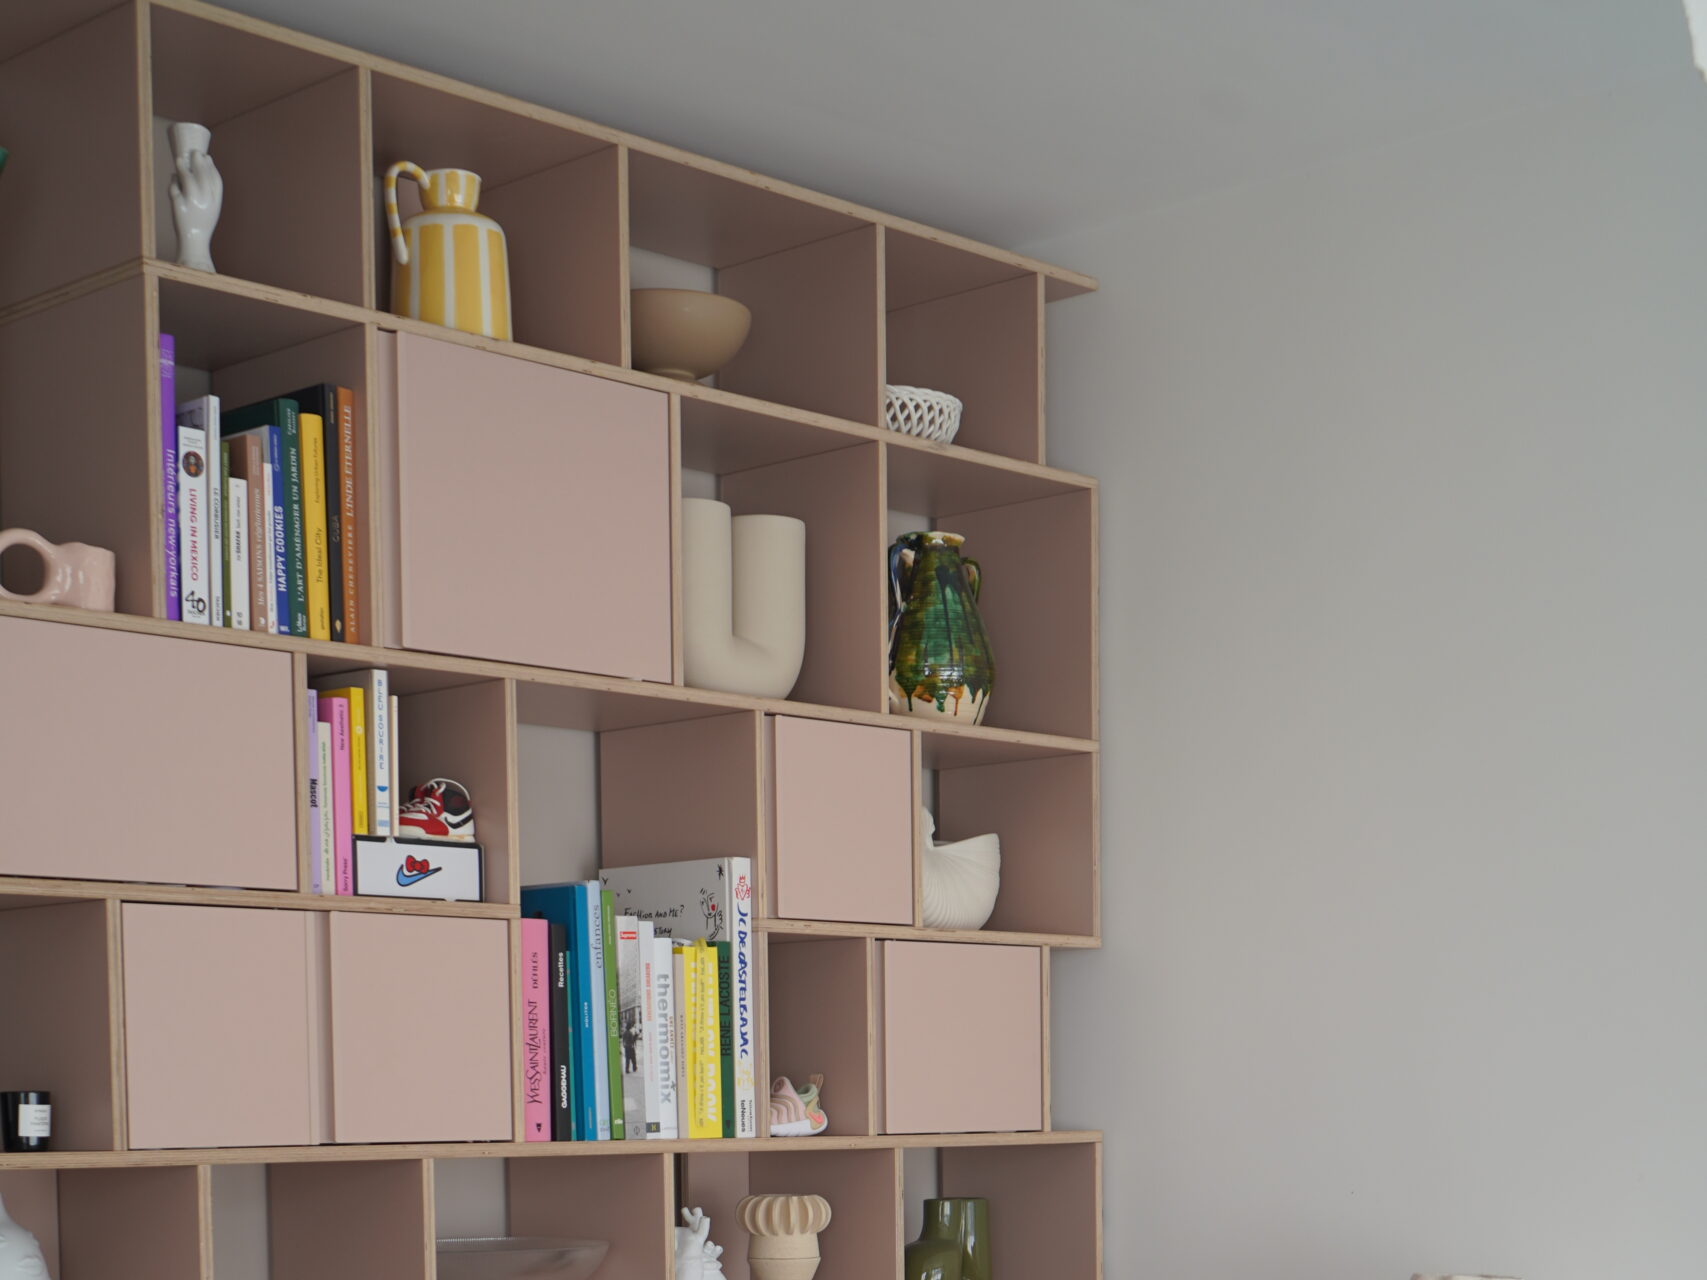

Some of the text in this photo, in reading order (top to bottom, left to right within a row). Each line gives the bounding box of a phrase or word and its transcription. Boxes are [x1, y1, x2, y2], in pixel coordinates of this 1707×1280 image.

[289, 448, 299, 483] JARDIN
[291, 485, 299, 501] UN
[166, 448, 180, 598] Intérieurs new-yorkais
[188, 488, 200, 581] LIVING IN MEXICO
[274, 505, 288, 592] HAPPY COOKIES
[314, 527, 323, 583] The Ideal City
[297, 574, 306, 602] L'ART
[309, 778, 318, 808] Mascot
[592, 904, 603, 969] enfances
[608, 988, 619, 1037] BORNÉO
[718, 955, 731, 1018] LACOSTE
[656, 973, 674, 1104] thermomix
